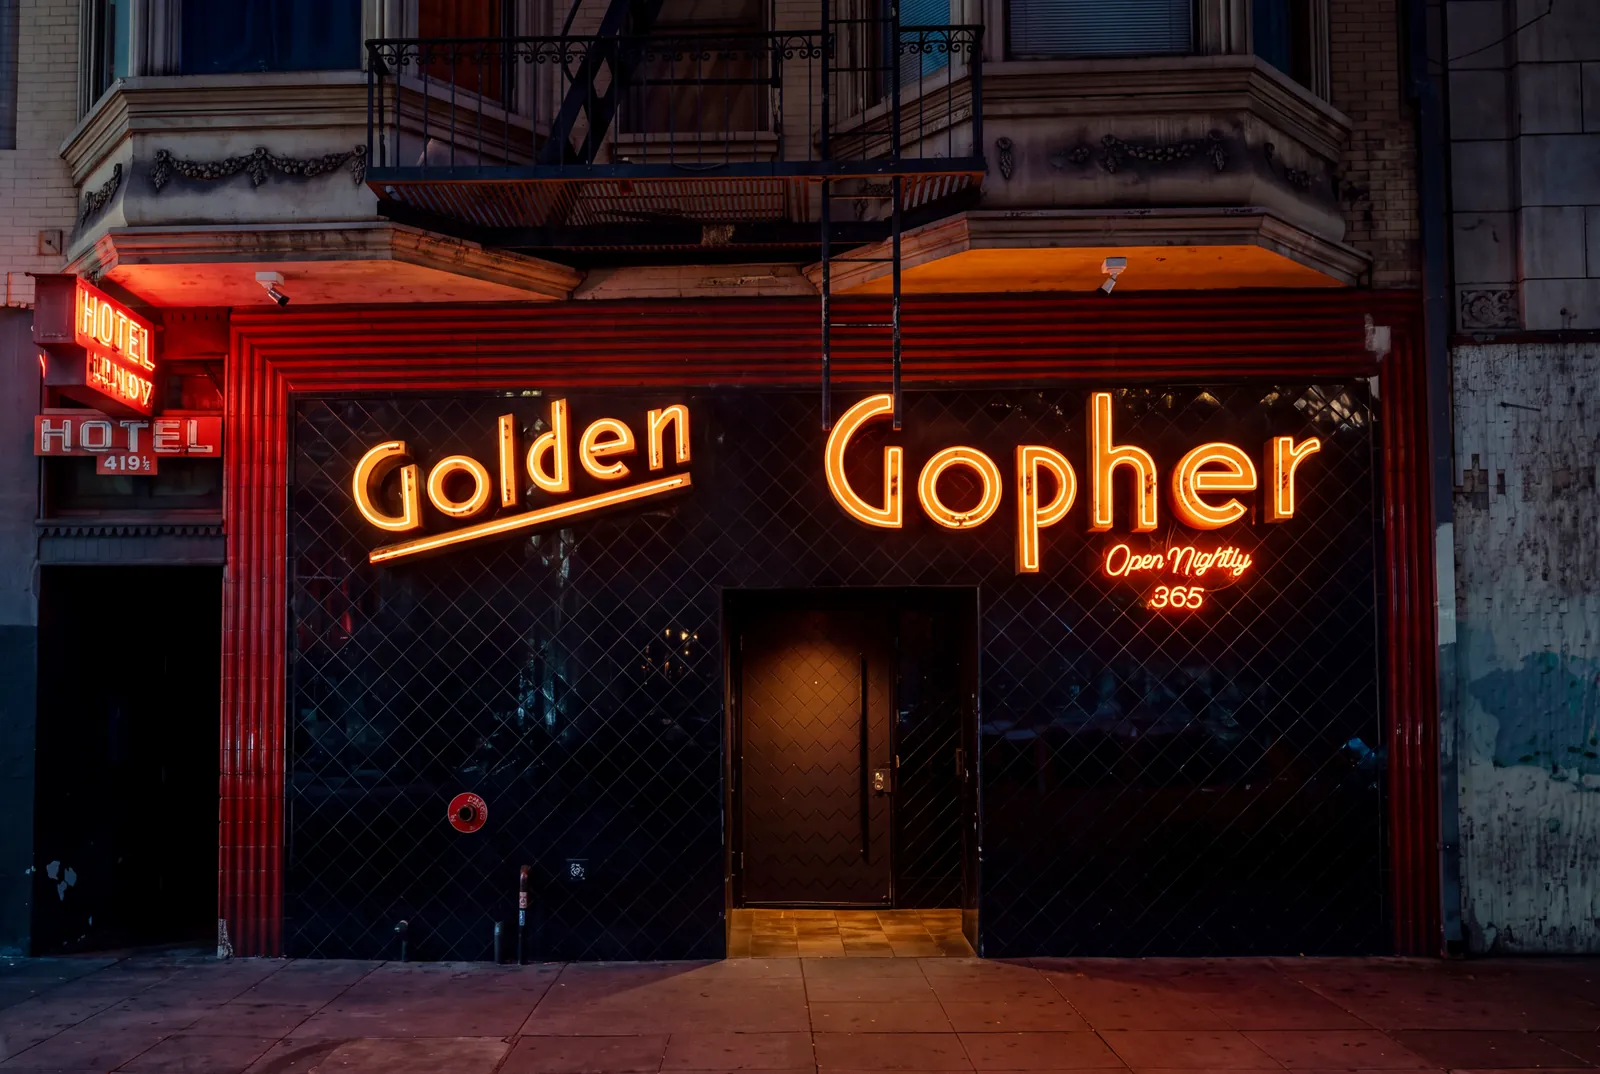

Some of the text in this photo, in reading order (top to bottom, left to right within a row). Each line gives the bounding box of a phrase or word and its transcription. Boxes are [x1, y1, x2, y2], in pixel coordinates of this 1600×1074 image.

[82, 289, 155, 371] HOTEL
[41, 419, 213, 453] HOTEL
[352, 391, 1321, 574] Golden Gopher
[1105, 543, 1253, 577] Open Nightly
[1151, 585, 1205, 609] 365
